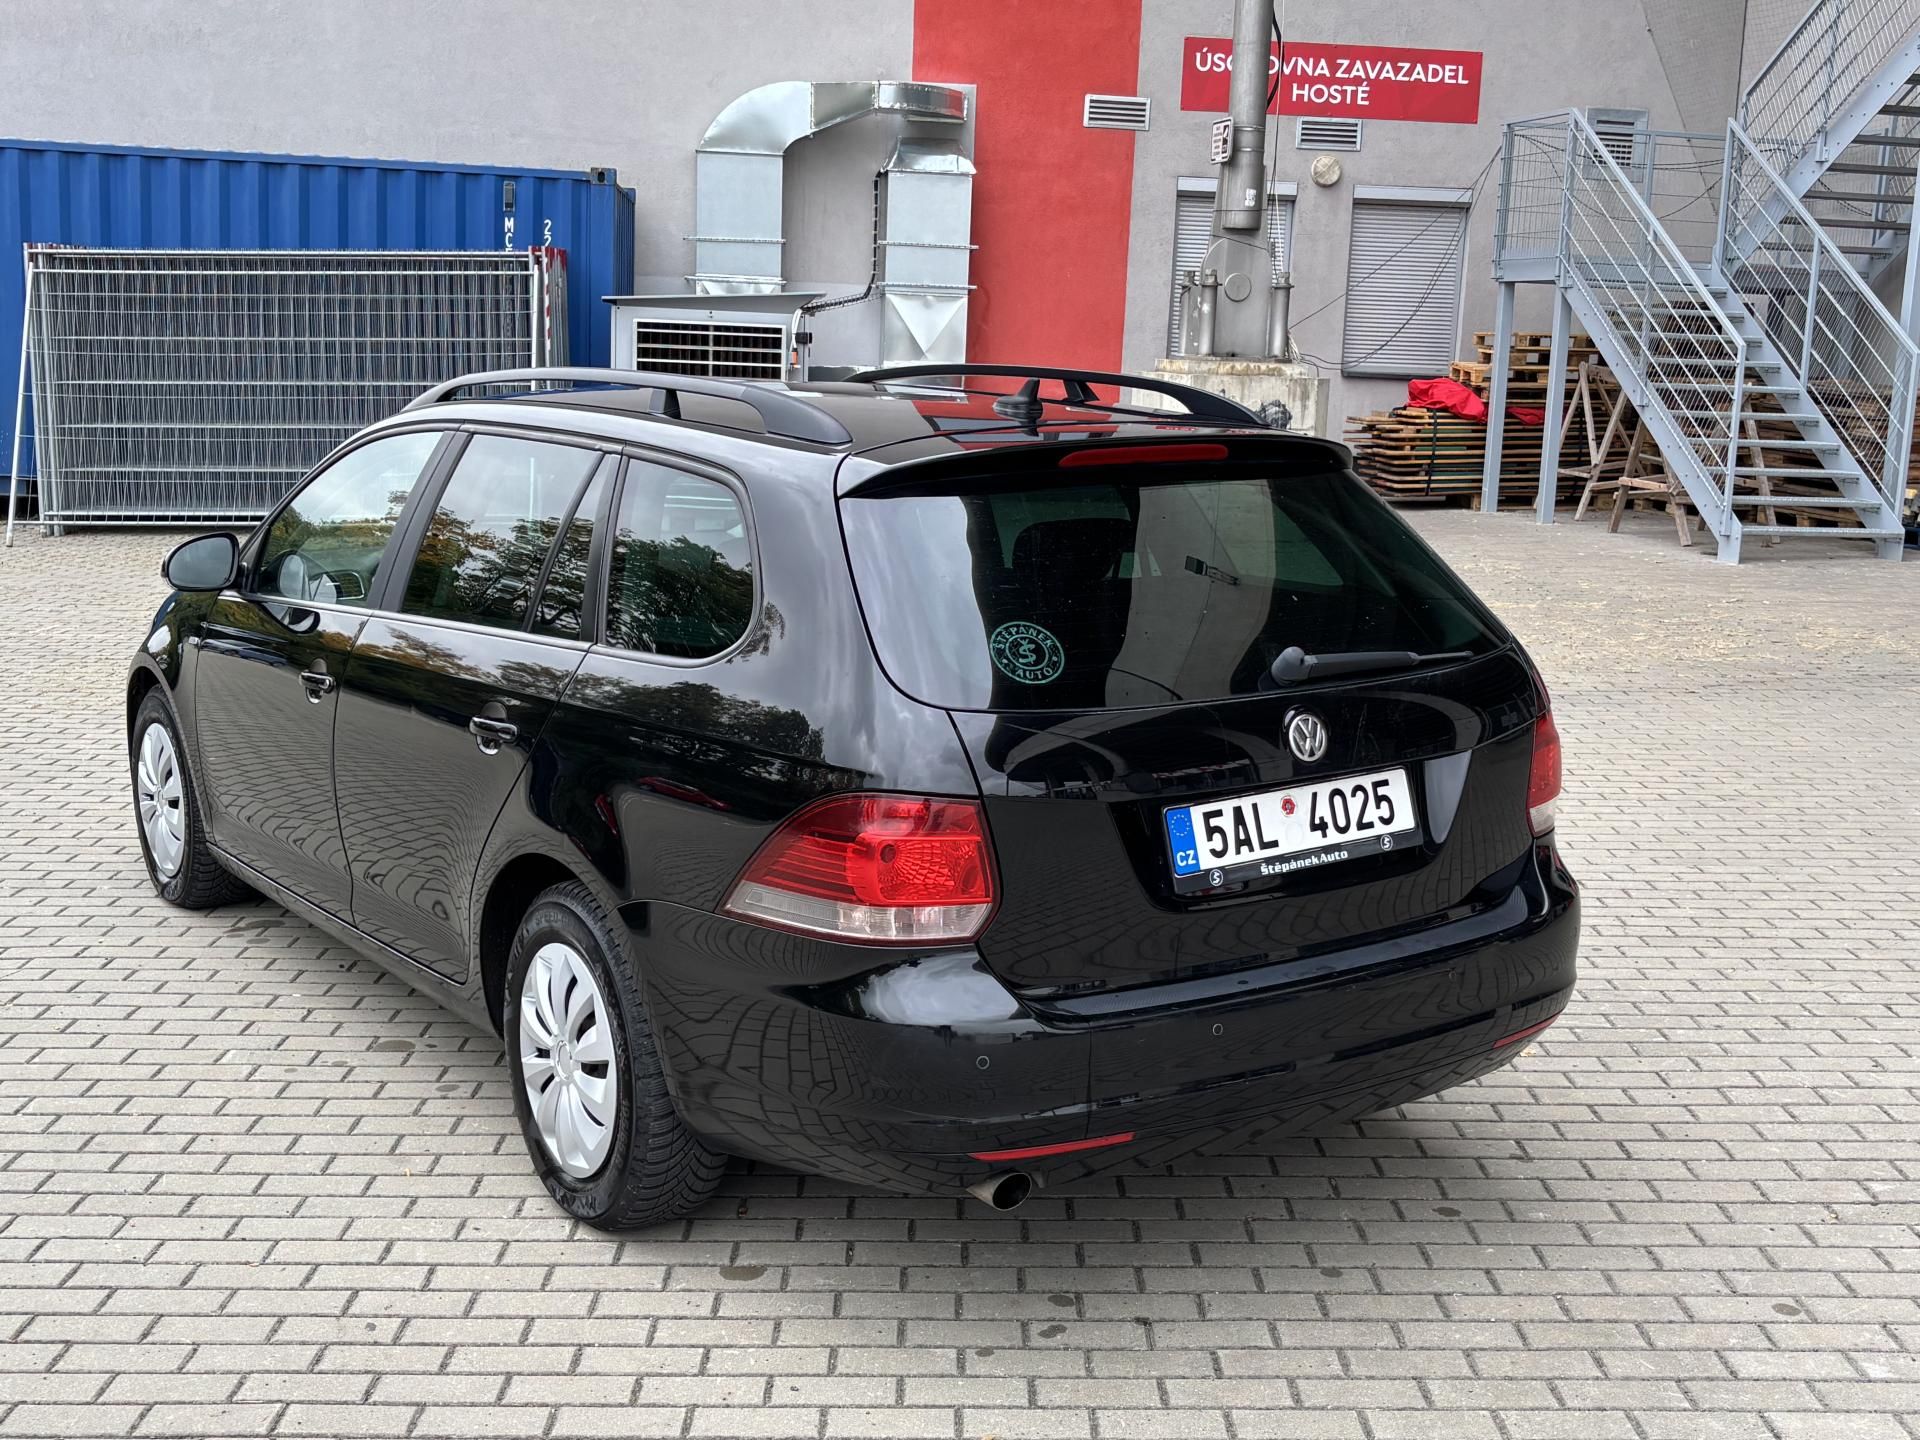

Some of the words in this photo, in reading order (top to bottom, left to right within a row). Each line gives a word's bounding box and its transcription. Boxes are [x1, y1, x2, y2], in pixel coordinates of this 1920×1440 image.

[1195, 47, 1330, 78] ÚSOVNA
[1335, 58, 1470, 86] ZAVAZADEL
[1291, 81, 1371, 106] HOSTÉ
[1015, 667, 1053, 679] AUTO
[1202, 802, 1279, 859] 5AL
[1309, 778, 1395, 839] 4025
[1176, 850, 1197, 867] CZ
[1260, 850, 1349, 875] ŠtěpánekAuto
